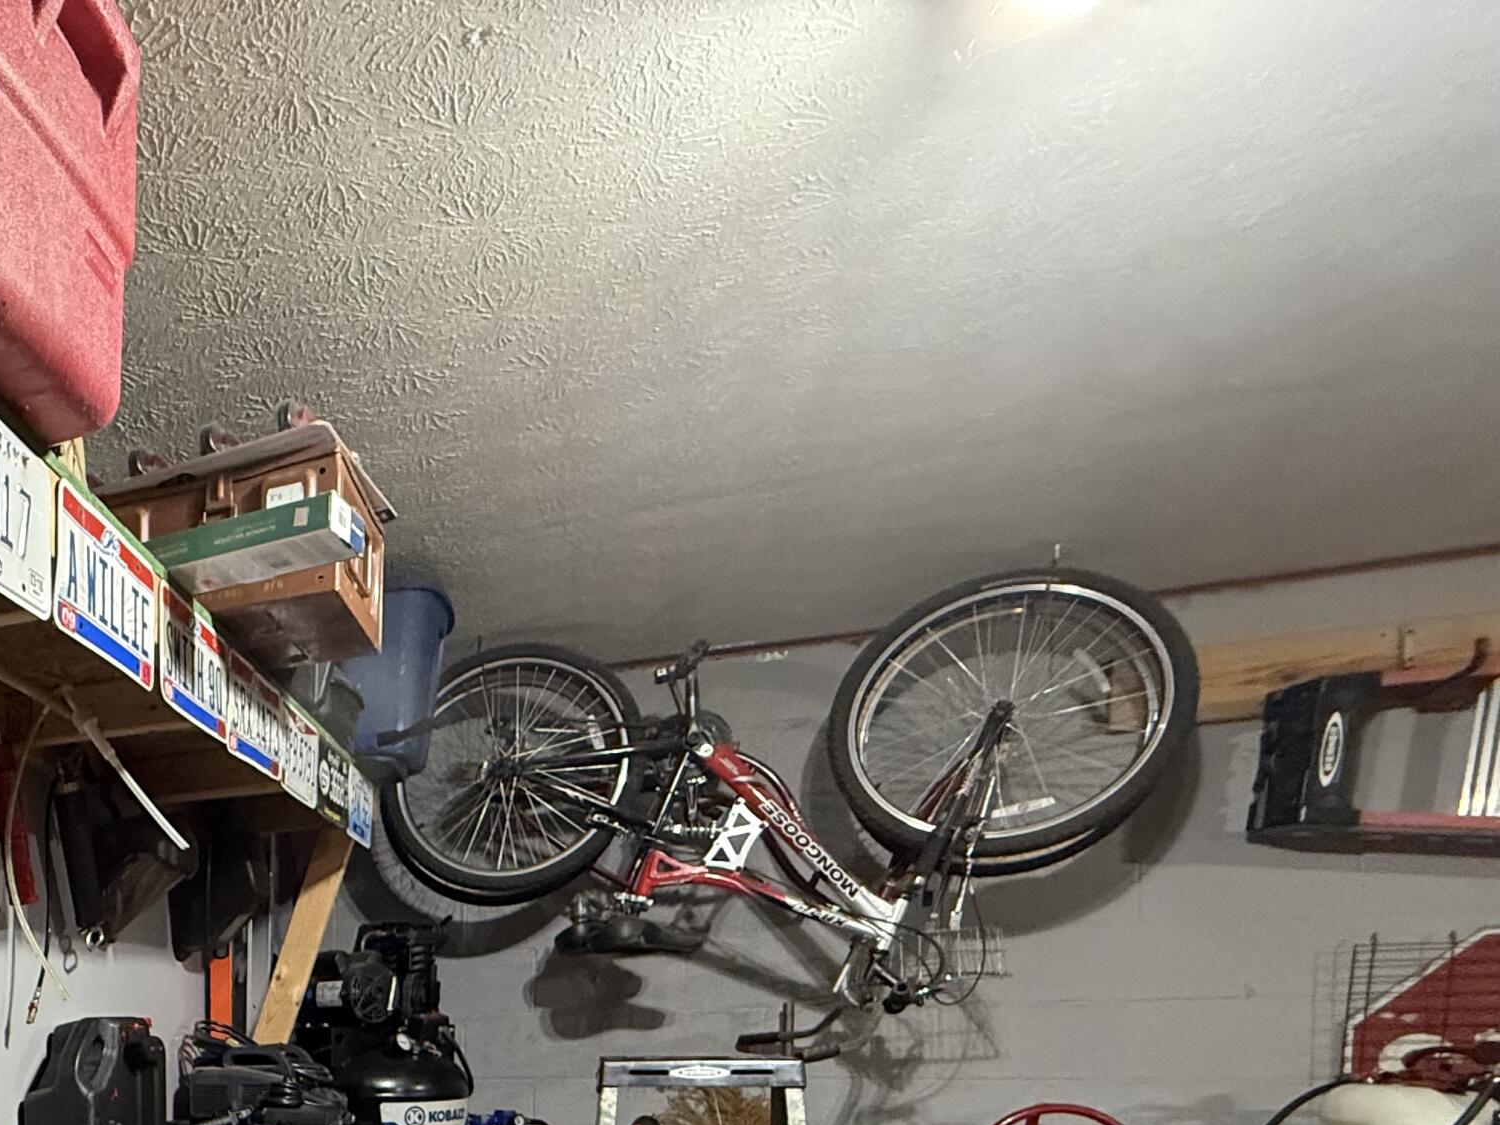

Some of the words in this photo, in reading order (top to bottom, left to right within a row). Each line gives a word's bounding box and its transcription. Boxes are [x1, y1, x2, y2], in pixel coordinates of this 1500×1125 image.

[61, 606, 76, 631] 09
[66, 529, 78, 604] A
[86, 539, 149, 658] WILLIE
[166, 621, 204, 703] SMITH
[208, 660, 222, 715] 90
[759, 799, 860, 900] MONGOOSE
[428, 1108, 465, 1123] KOBALT
